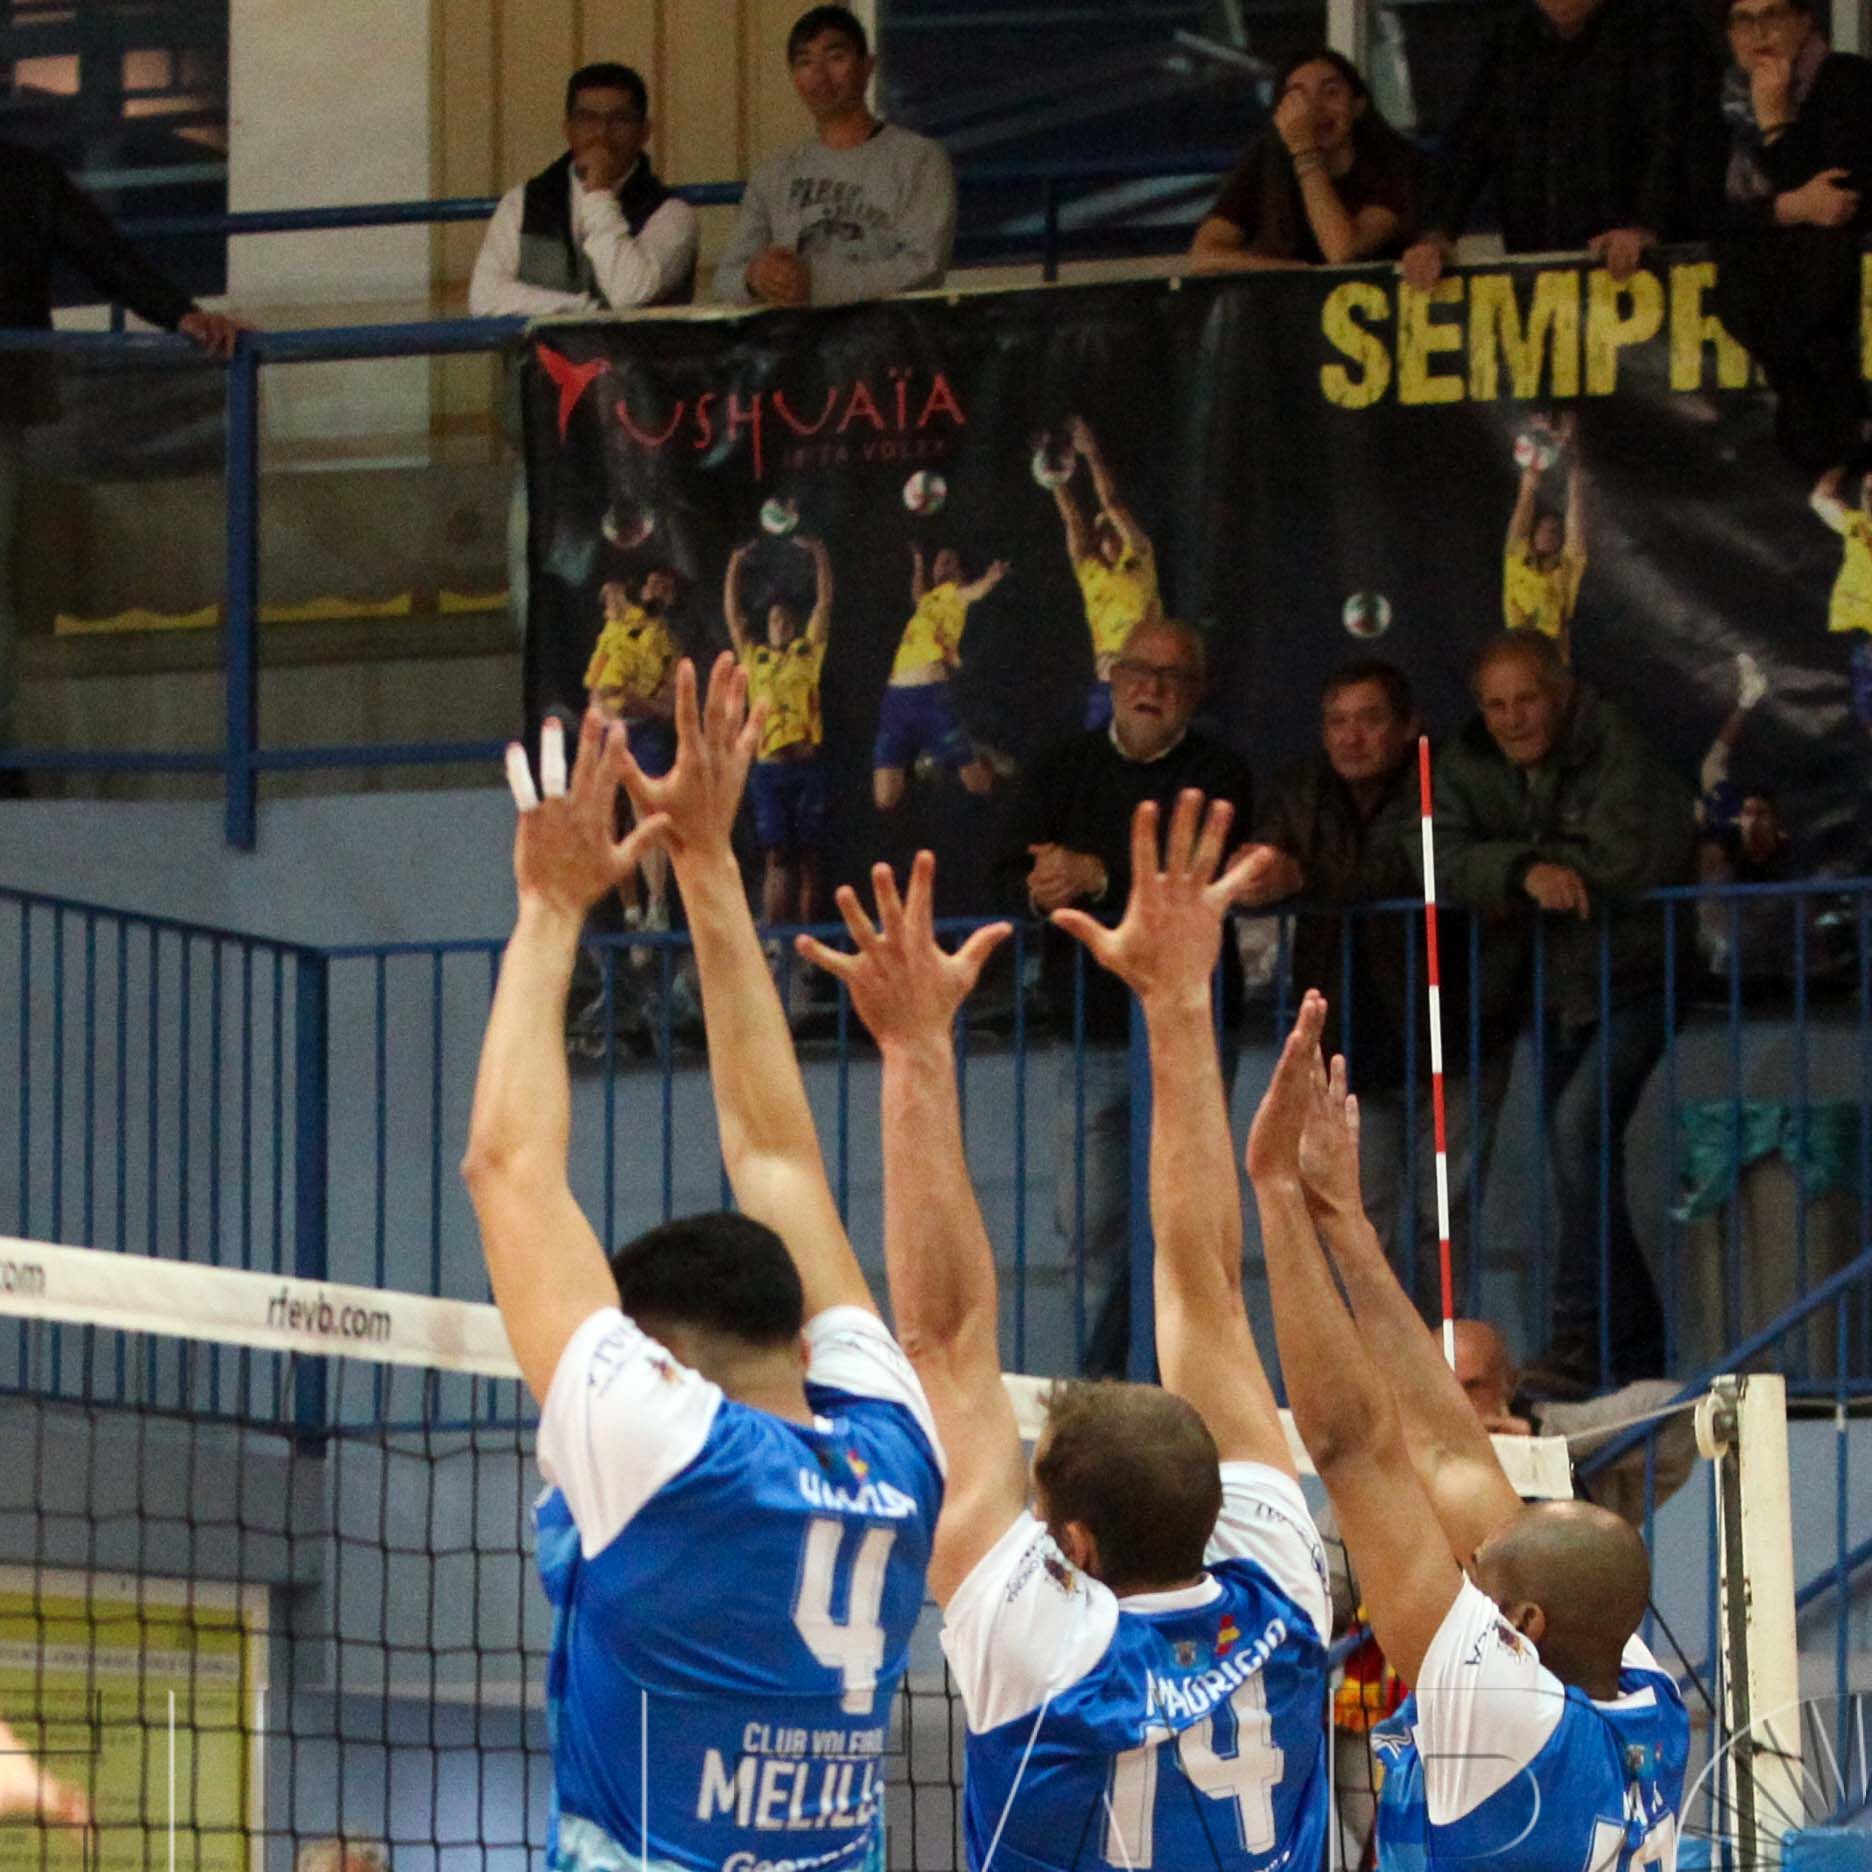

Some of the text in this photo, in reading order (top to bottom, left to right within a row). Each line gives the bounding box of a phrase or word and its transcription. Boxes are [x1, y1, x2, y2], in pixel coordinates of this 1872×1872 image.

[1318, 258, 1768, 411] SEMPR
[266, 1287, 394, 1343] rfevb.com
[790, 1516, 897, 1716] 4
[1145, 1617, 1288, 1719] MAURICIO
[743, 1721, 808, 1760] CLUB
[1102, 1668, 1286, 1871] 14
